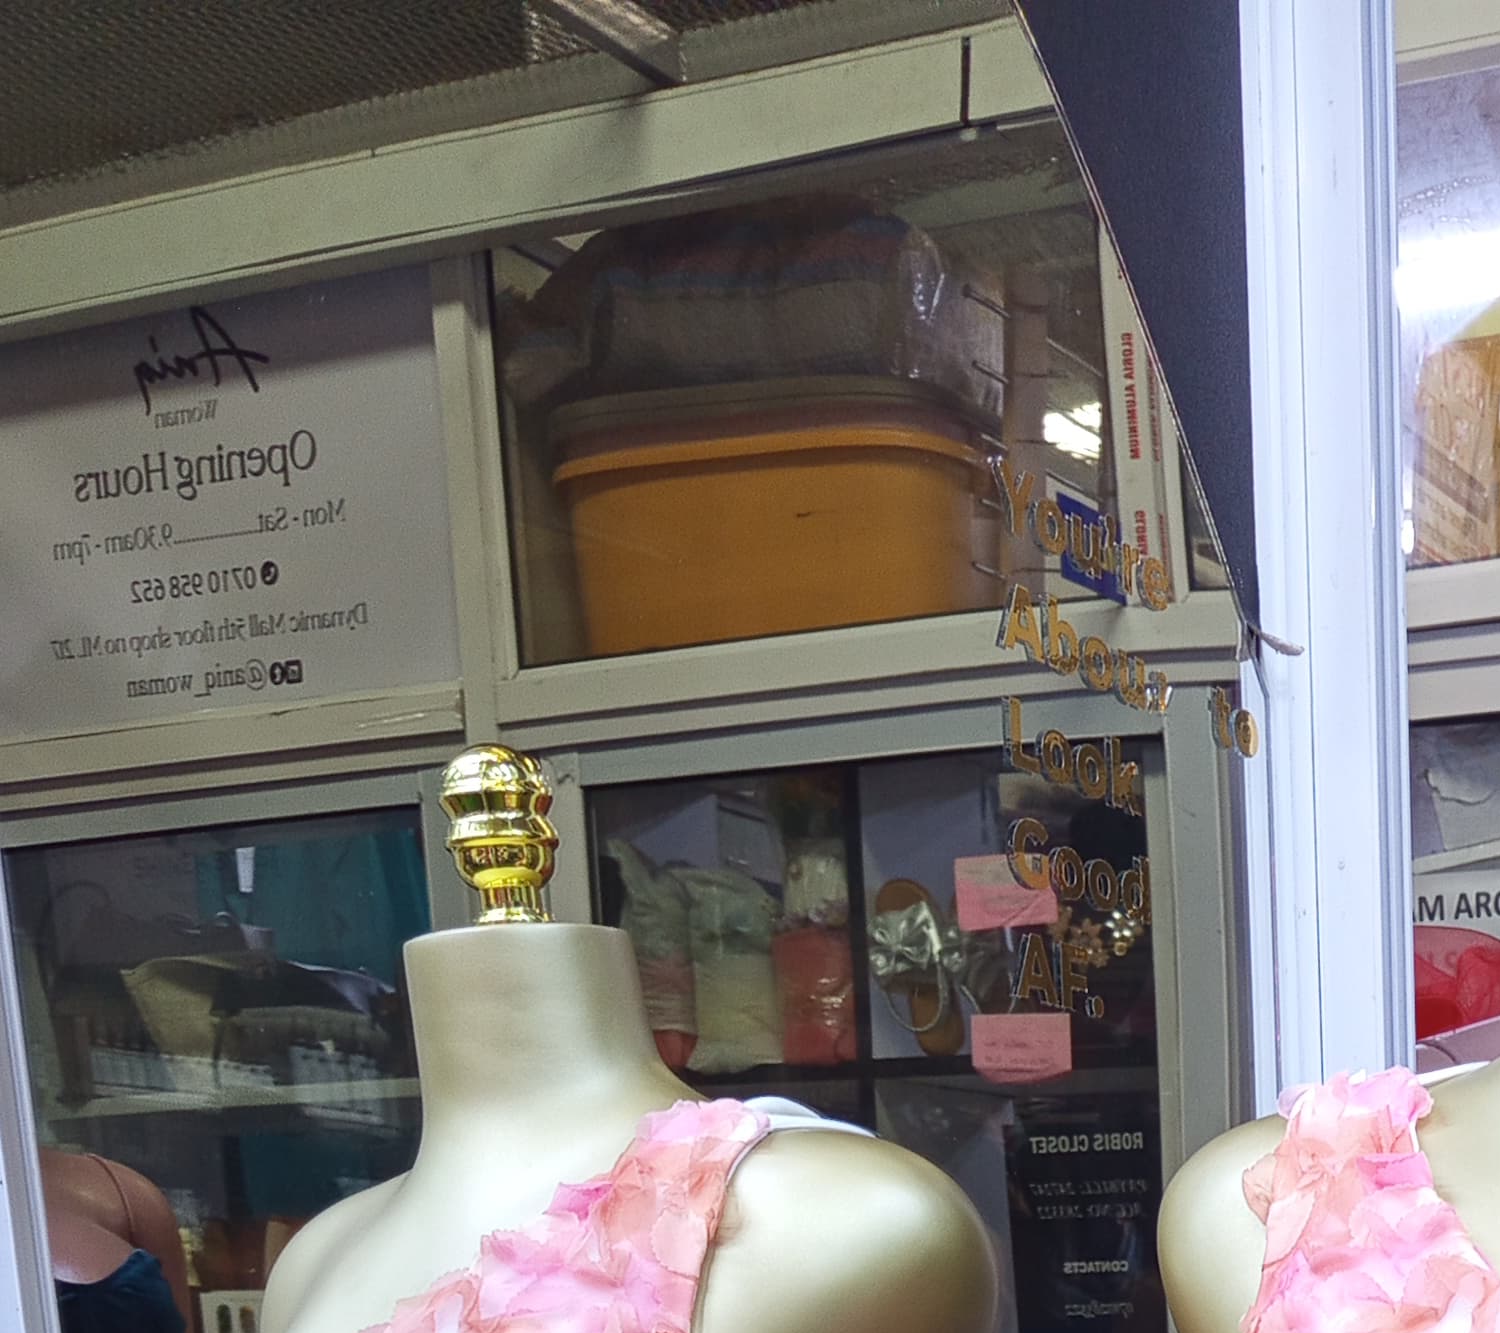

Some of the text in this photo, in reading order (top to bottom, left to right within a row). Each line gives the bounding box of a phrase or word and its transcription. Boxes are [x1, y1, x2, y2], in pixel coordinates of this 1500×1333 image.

[986, 455, 1169, 611] You're
[1001, 695, 1142, 816] Look
[1413, 894, 1445, 922] M
